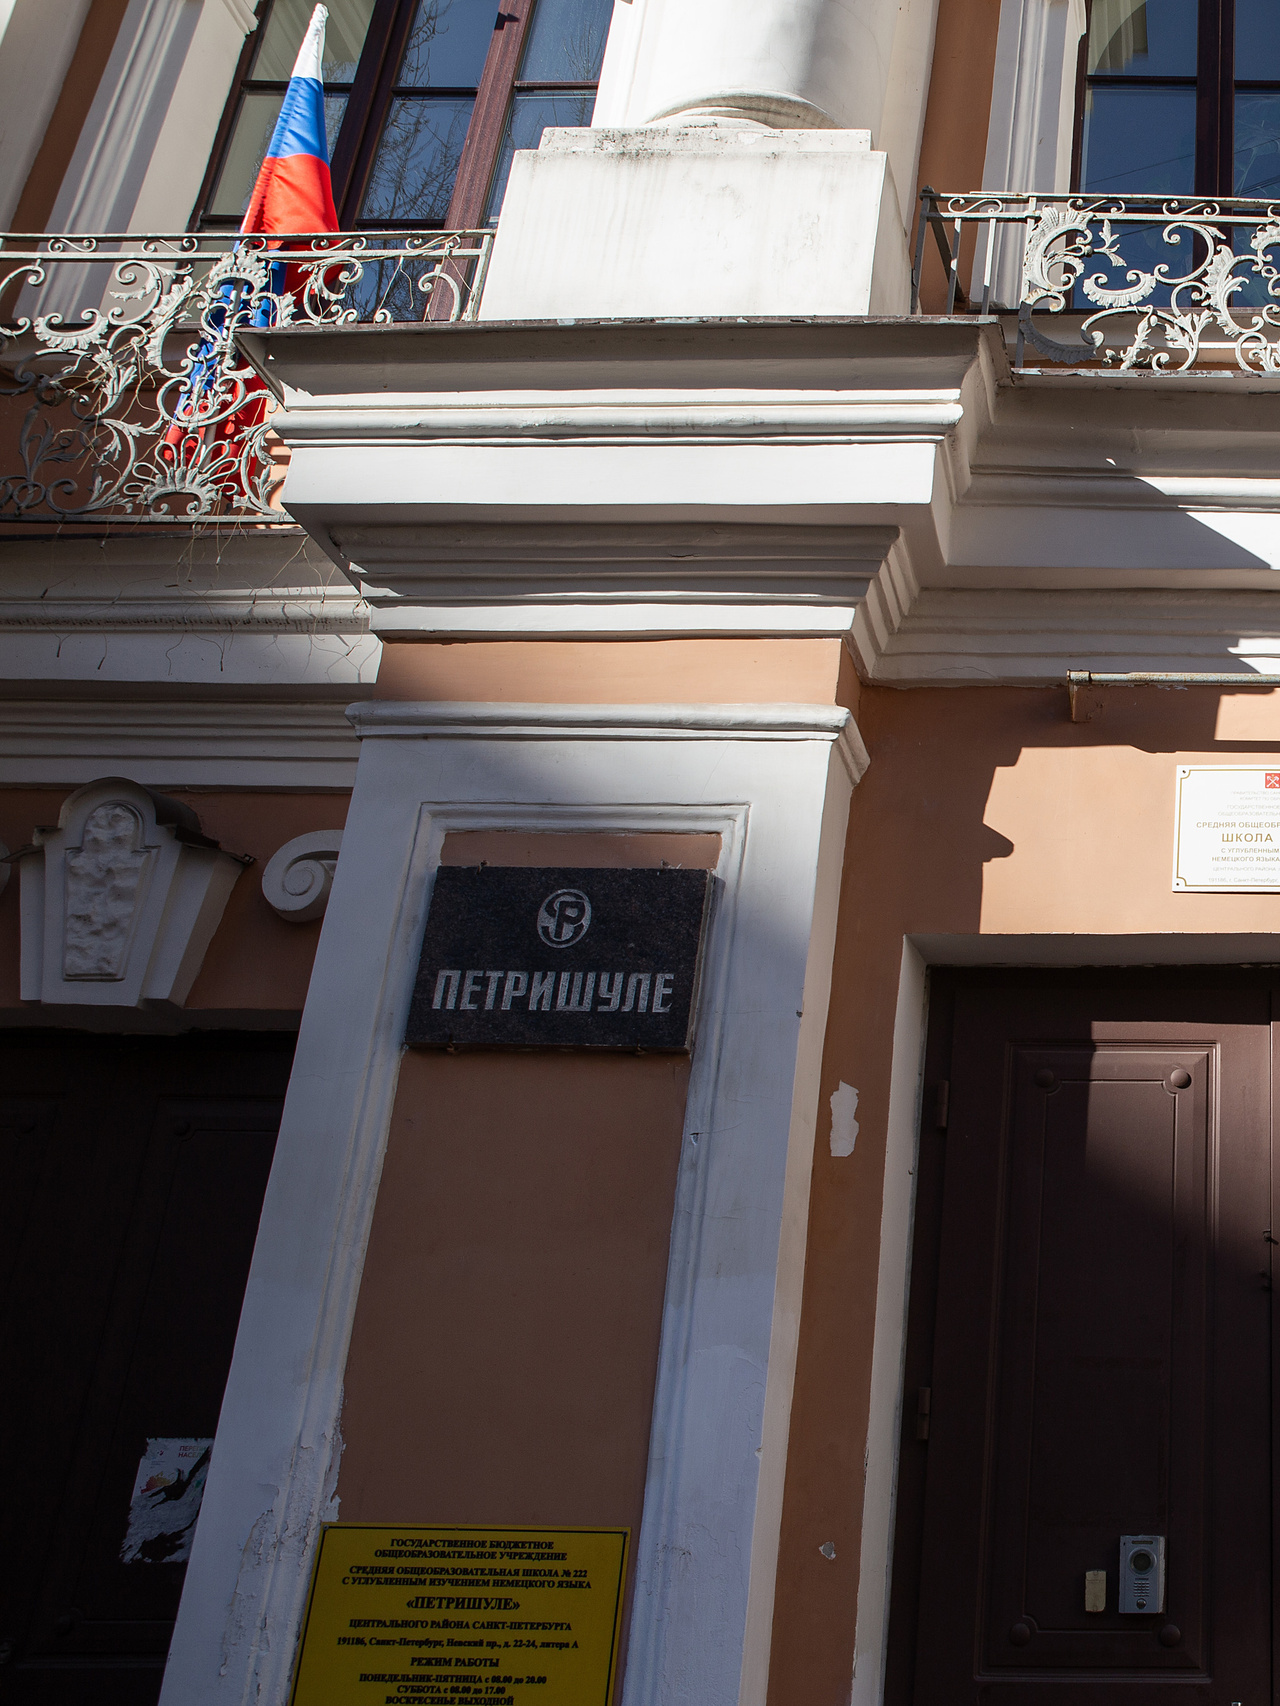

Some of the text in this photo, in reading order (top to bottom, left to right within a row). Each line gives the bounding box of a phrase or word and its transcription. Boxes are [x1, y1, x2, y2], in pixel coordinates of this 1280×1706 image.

[1196, 821, 1236, 829] СРЕДНЯЯ
[1221, 833, 1274, 843] ШКОЛА
[431, 969, 675, 1013] ПЕТРИШУЛЕ
[390, 1538, 554, 1550] ГОСУДАРСТВЕННОЕ БЮДЖЕТНОЕ
[374, 1549, 568, 1562] ОБЩЕОБРАЗОВАТЕЛЬНОЕ УЧРЕЖДЕНИЕ
[349, 1566, 395, 1576] СРЕДНЯЯ
[396, 1566, 520, 1578] ОБЩЕОБРАЗОВАТЕЛЬНАЯ
[522, 1568, 559, 1578] ШКОЛА
[573, 1570, 588, 1578] 222
[342, 1577, 592, 1589] С УГЛУБЛЕННЫМ ИЗУЧЕНИЕМ НЕМЕЦКОГО ЯЗЫКА
[406, 1596, 520, 1611] «ПЕТРИШУЛЕ»
[349, 1618, 572, 1631] ЦЕНТРАЛЬНОГО РАЙОНА САНКТ-ПЕТЕРБУРГА
[337, 1637, 367, 1647] 191186,
[369, 1637, 445, 1649] Санкт-Петербург,
[446, 1638, 484, 1648] Невский
[512, 1640, 538, 1650] 22-24,
[539, 1642, 570, 1651] литера
[571, 1640, 579, 1649] А
[410, 1657, 500, 1667] РЕЖИМ РАБОТЫ
[359, 1673, 483, 1685] ПОНЕДЕЛЬНИК-ПЯТНИЦА
[491, 1675, 512, 1684] 08.00
[513, 1677, 524, 1685] до
[525, 1675, 547, 1684] 20.00
[397, 1685, 442, 1694] СУББОТА
[450, 1686, 471, 1695] 08.00
[472, 1687, 483, 1696] до
[484, 1686, 506, 1695] 17.00
[385, 1695, 514, 1706] ВОСКРЕСЕНЬЕ ВЫХОДНОЙ
